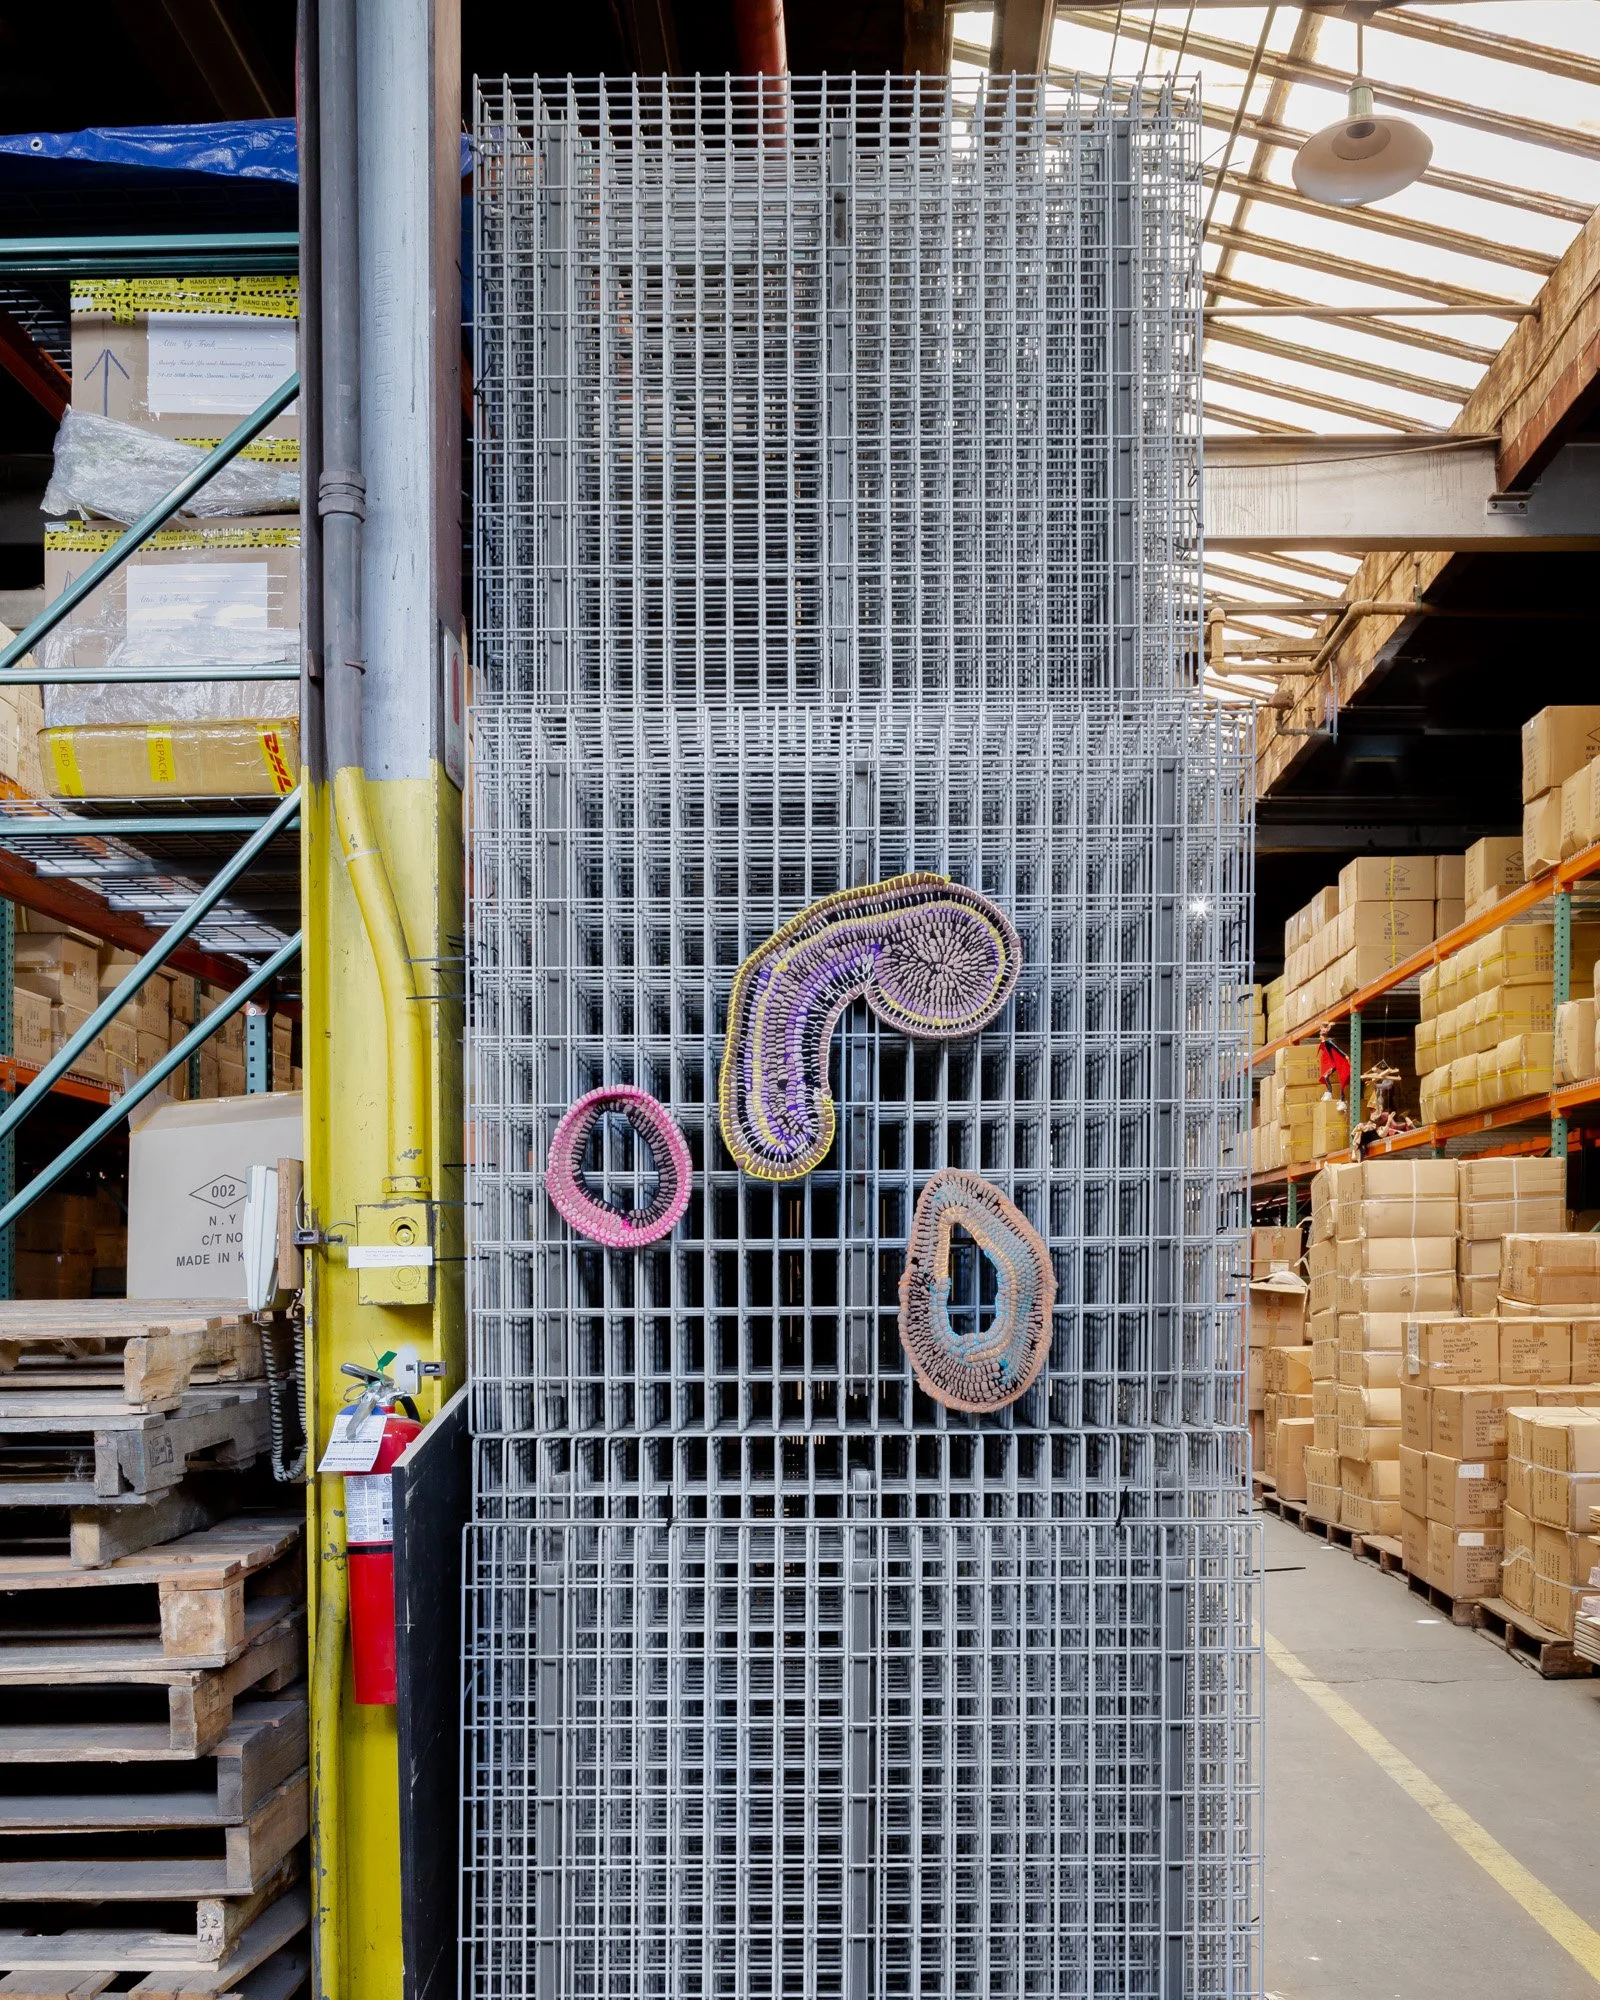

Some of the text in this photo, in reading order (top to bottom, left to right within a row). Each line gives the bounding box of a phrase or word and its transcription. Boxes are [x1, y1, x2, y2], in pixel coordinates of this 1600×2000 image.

[264, 730, 293, 793] DHL
[211, 1184, 236, 1198] 002
[202, 1233, 222, 1246] C/T
[176, 1254, 210, 1267] MADE
[218, 1252, 230, 1263] IN
[199, 1913, 221, 1929] 32
